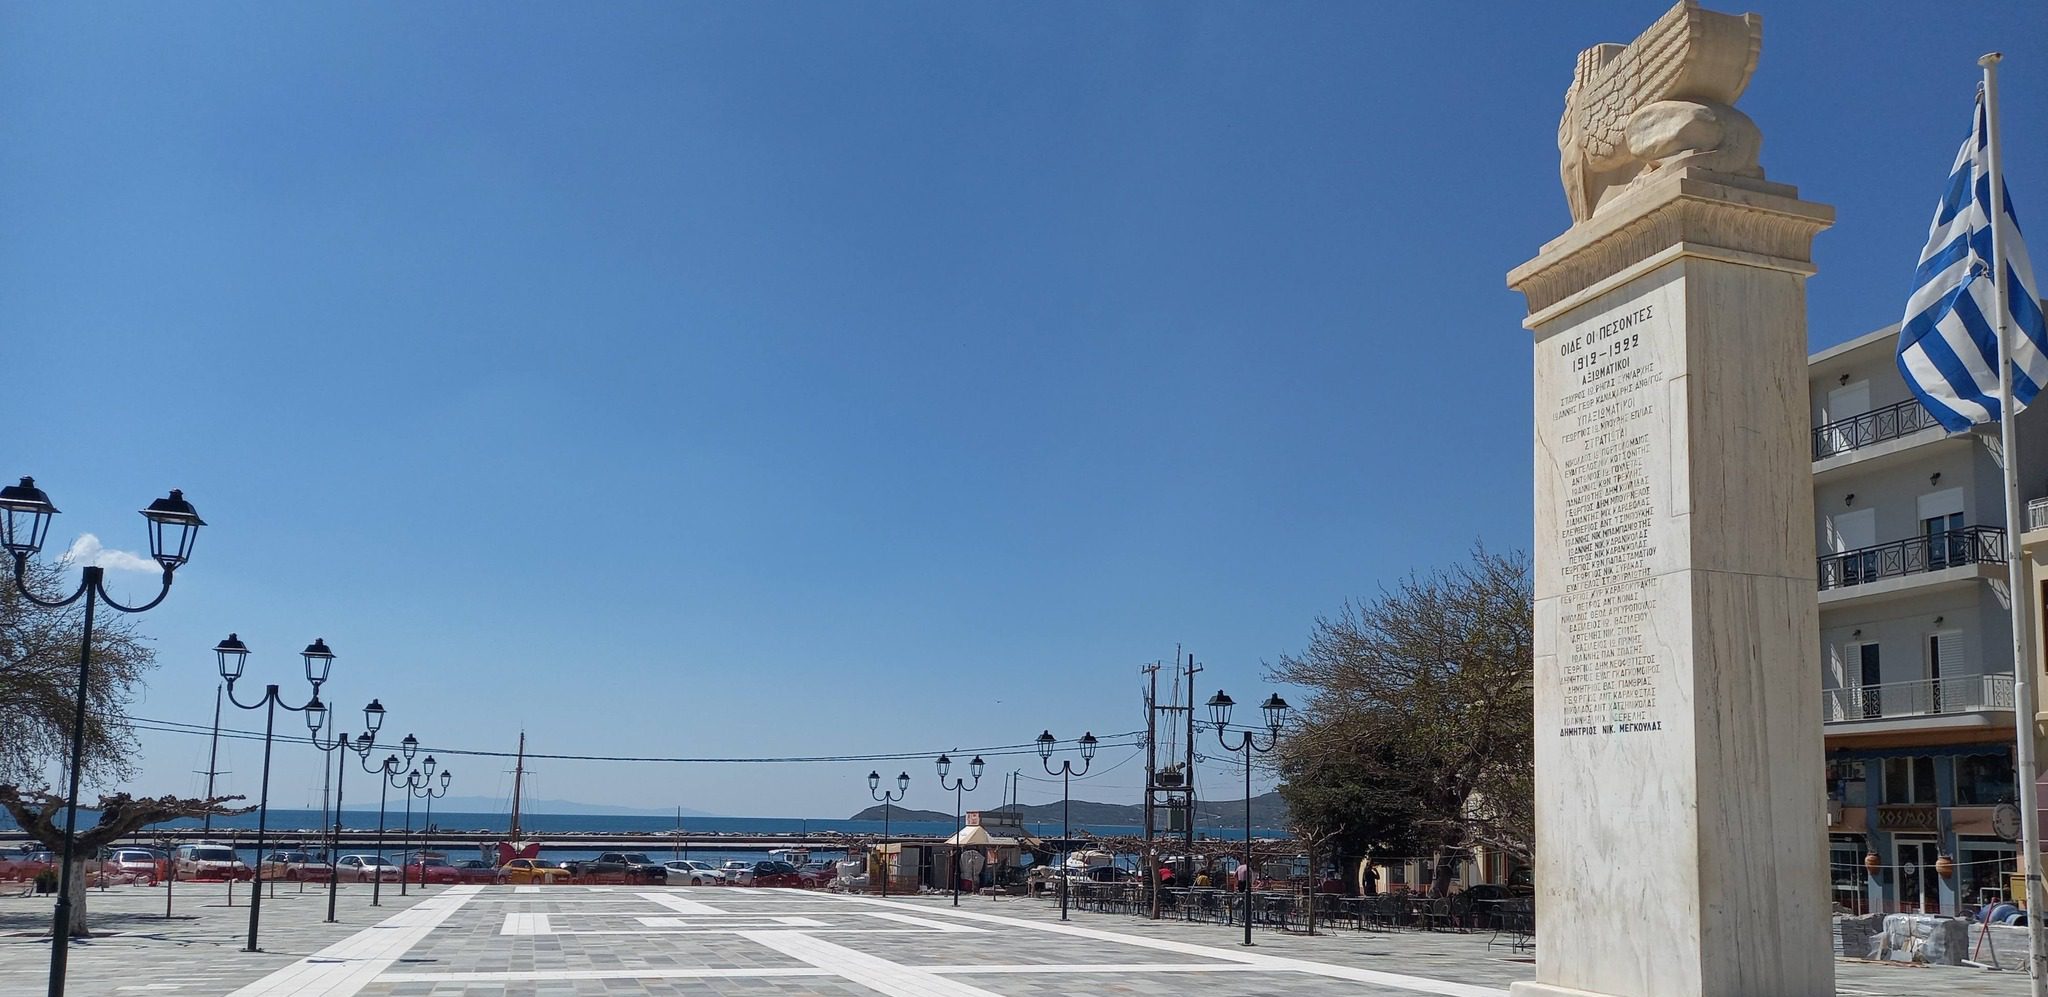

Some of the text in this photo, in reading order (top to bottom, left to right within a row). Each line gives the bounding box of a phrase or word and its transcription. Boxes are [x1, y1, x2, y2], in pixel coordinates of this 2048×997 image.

[1561, 305, 1653, 357] ΟΙΔΕ ΟΙ ΠΕΣΟΝΤΕΣ
[1582, 357, 1629, 385] ΑΞΙΩΜΑΤΙΚΟΙ
[1560, 721, 1661, 737] ΔΗΜΗΤΡΙΟΣ ΝΙΚ. ΜΕΓΚΟΥΛΑΣ
